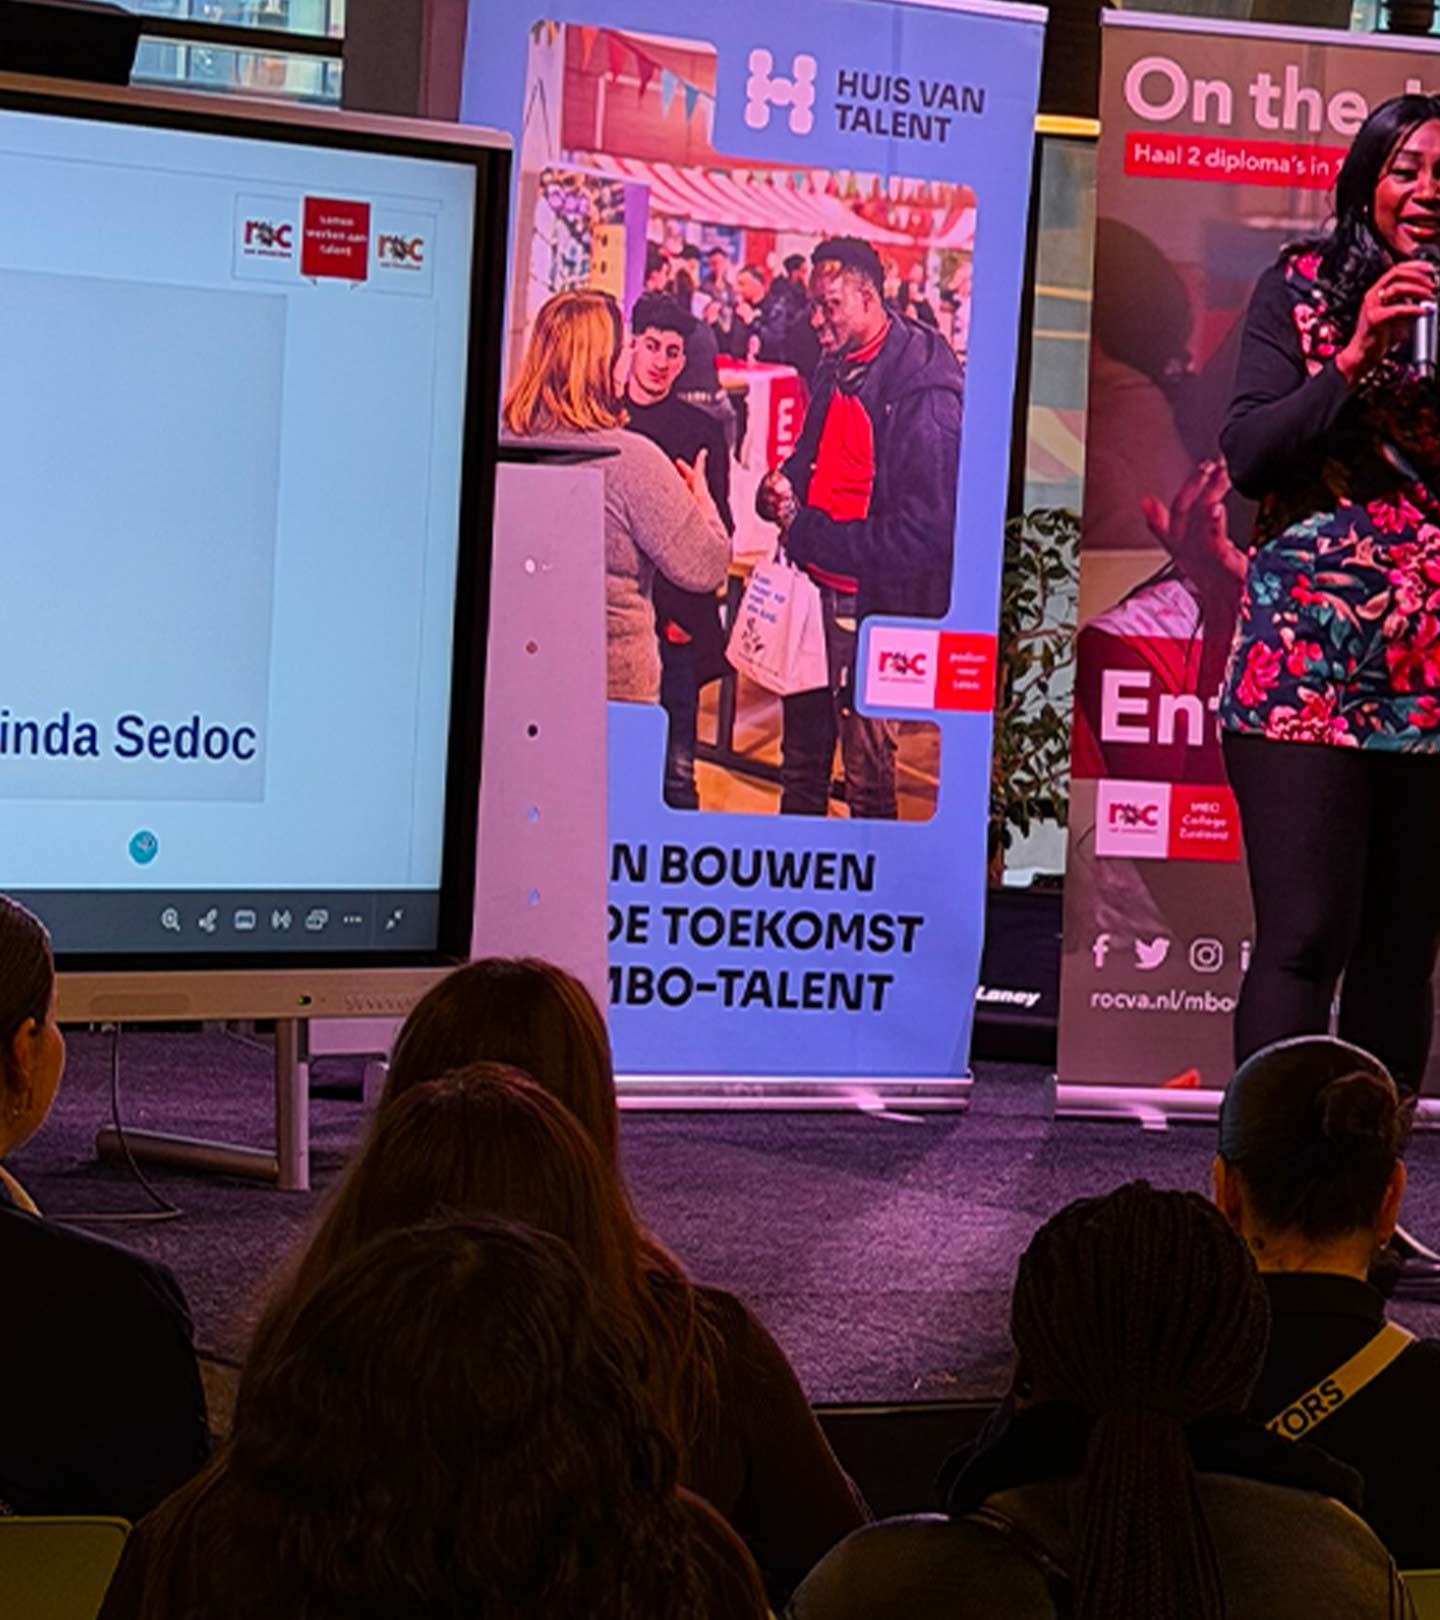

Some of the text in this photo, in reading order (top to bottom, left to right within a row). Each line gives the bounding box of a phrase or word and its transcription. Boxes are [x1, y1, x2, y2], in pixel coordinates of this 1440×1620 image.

[838, 69, 985, 114] HUIS VAN
[1124, 56, 1233, 125] On
[1249, 65, 1369, 136] the
[835, 103, 952, 143] TALENT
[1134, 143, 1182, 166] Haal
[1187, 146, 1201, 167] 2
[1205, 147, 1306, 174] diploma's
[1310, 155, 1330, 176] in
[1100, 668, 1222, 746] En
[114, 714, 257, 761] Sedoc
[660, 845, 876, 892] BOUWEN
[662, 907, 924, 952] TOEKOMST
[976, 985, 1041, 1008] Laney
[1090, 988, 1238, 1013] rocva.nl/mbo
[1270, 1379, 1345, 1436] ORS
